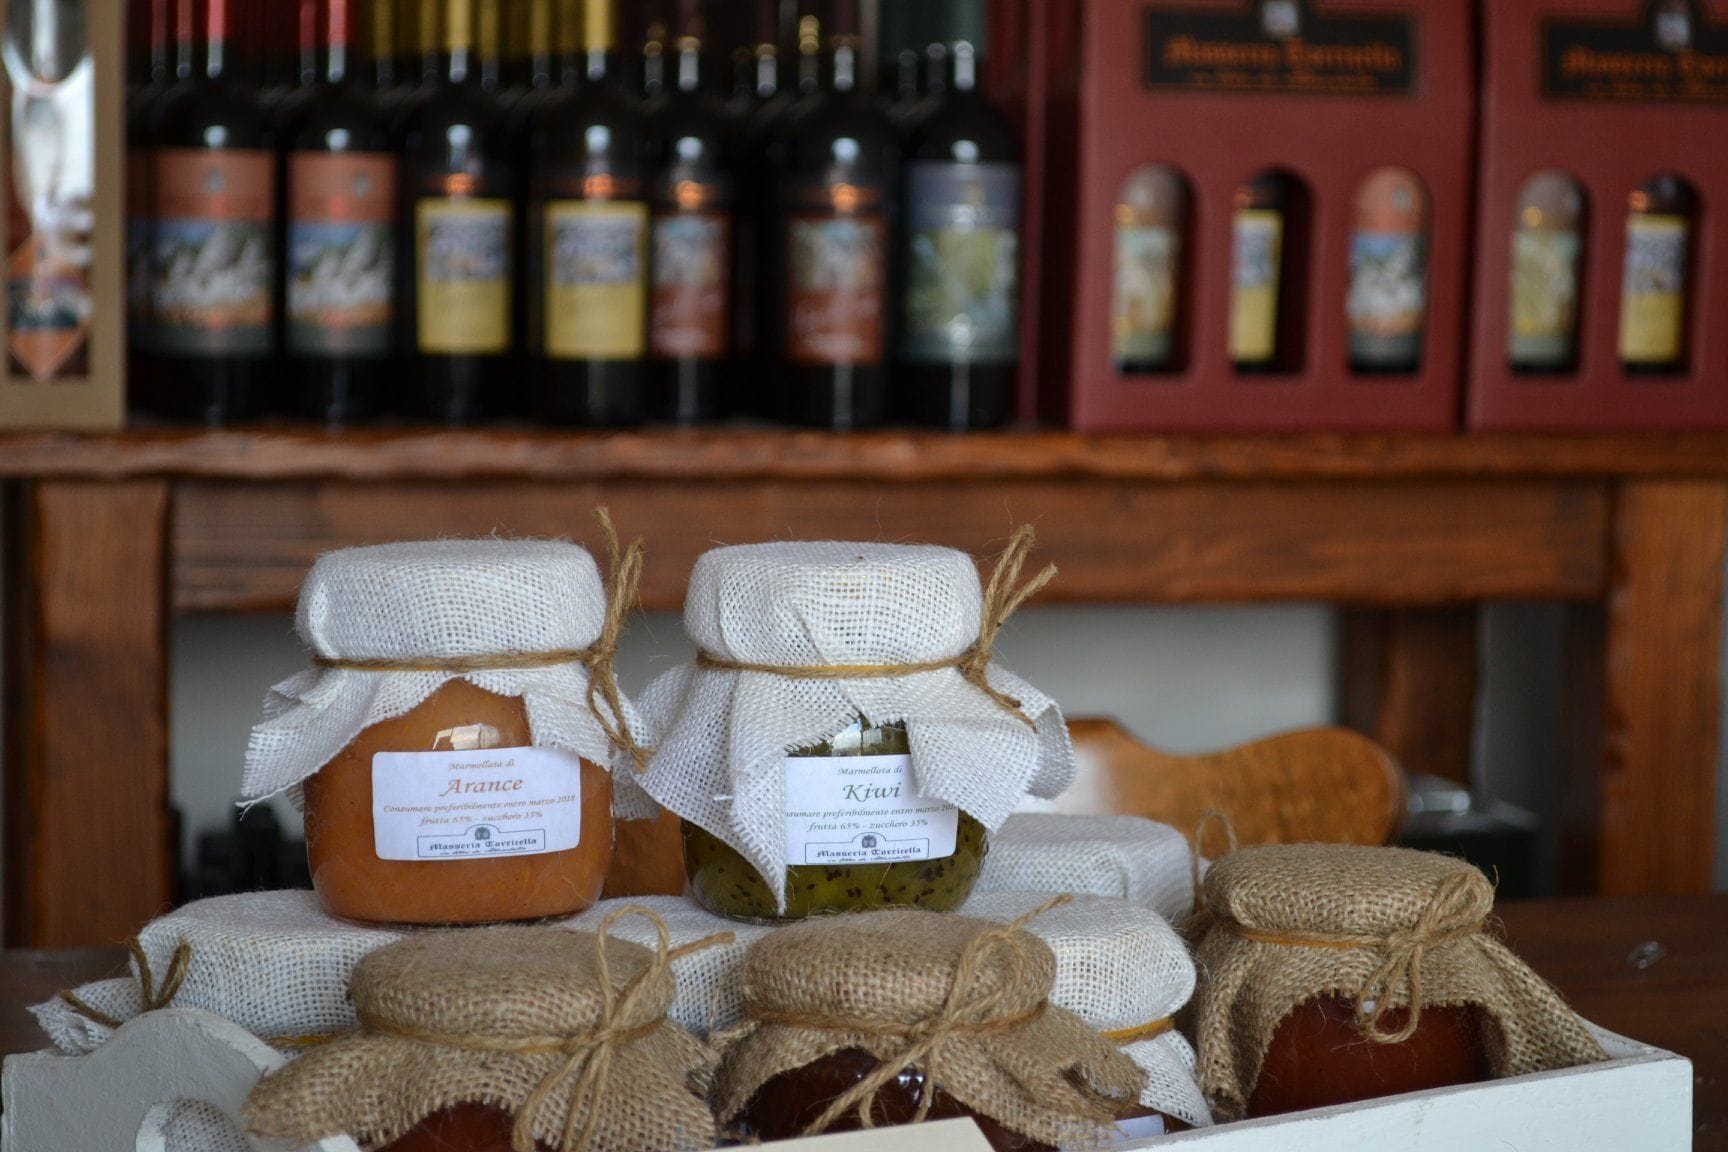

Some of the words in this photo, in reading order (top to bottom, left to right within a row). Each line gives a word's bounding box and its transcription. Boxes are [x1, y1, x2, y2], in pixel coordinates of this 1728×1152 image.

[448, 760, 502, 771] Marmellata
[505, 758, 515, 767] di
[837, 766, 891, 776] Marmellata
[893, 765, 903, 774] di
[439, 777, 523, 797] Arance
[843, 782, 902, 803] Kiwi
[383, 804, 432, 814] Consumare
[434, 801, 502, 814] preferibilmente
[504, 800, 526, 808] entro
[529, 797, 555, 806] marzo
[418, 815, 449, 827] frutta
[482, 812, 521, 822] zucchero
[523, 810, 543, 819] 35%
[822, 807, 889, 819] preferibilmente
[807, 822, 837, 832] frutta
[840, 822, 860, 830] 65%
[869, 820, 907, 829] zucchero
[910, 818, 928, 827] 35%
[429, 842, 481, 851] Masseria
[484, 838, 537, 848] Torricella
[817, 849, 867, 858] Masseria
[871, 846, 921, 856] Torricella
